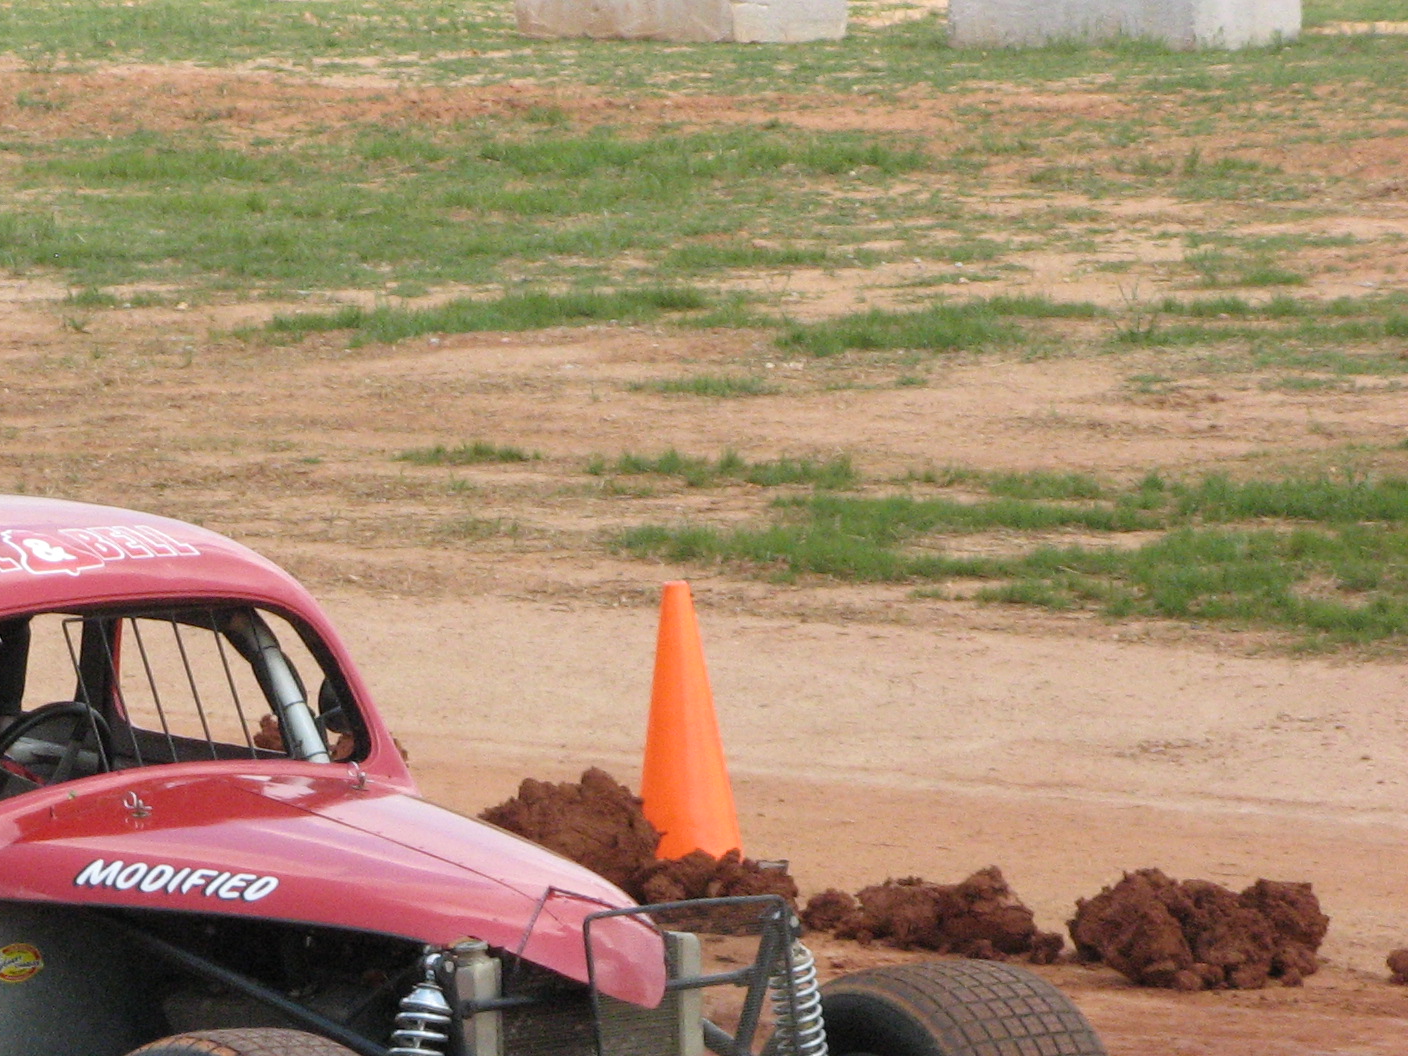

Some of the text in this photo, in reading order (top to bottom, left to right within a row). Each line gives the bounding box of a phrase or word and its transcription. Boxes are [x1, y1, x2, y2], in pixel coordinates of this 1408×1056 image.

[22, 538, 77, 563] &
[56, 525, 201, 561] BELL
[75, 859, 280, 902] MODIFIED
